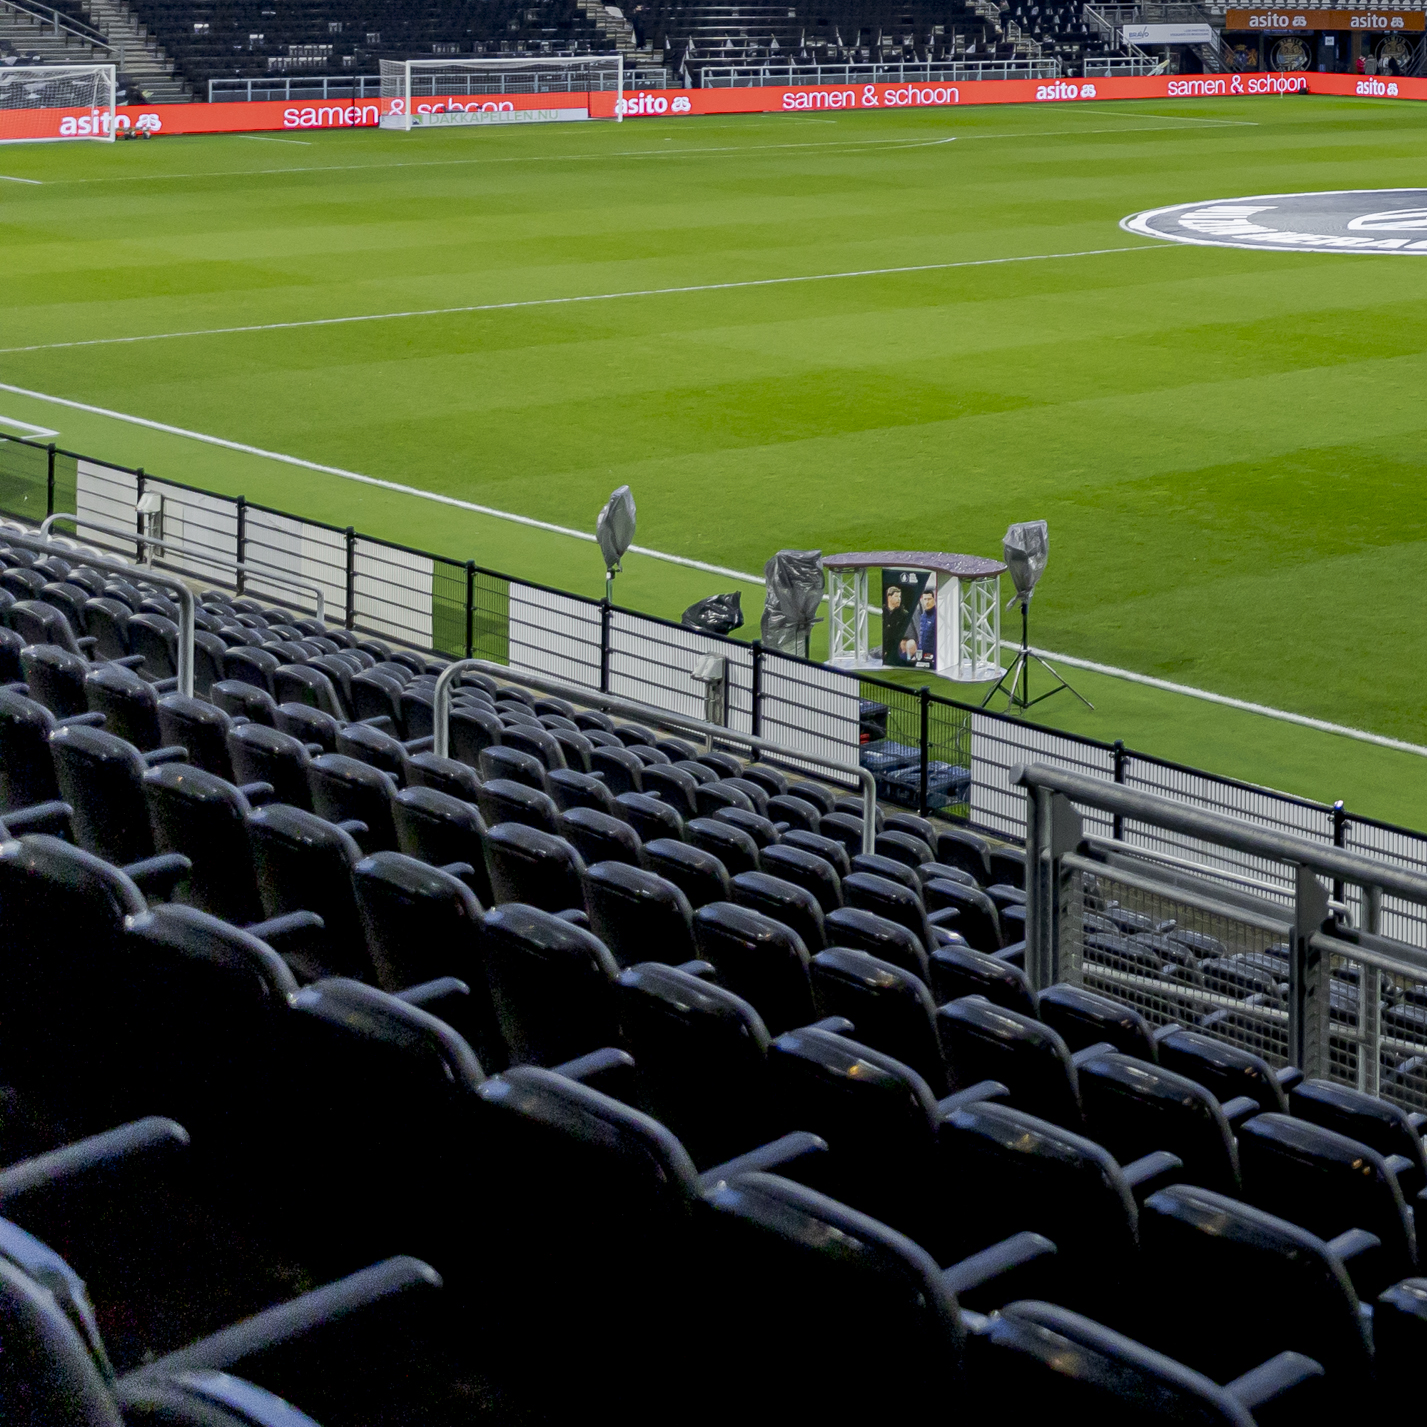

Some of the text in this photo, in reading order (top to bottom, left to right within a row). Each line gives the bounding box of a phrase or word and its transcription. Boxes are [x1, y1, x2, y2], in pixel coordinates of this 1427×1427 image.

[1249, 11, 1290, 28] asito
[1350, 12, 1388, 28] asito
[1036, 82, 1079, 100] asito
[1168, 73, 1307, 96] samen & schoon
[1355, 76, 1386, 96] asito
[615, 92, 668, 116] asito
[782, 83, 959, 110] samen & schoon
[60, 110, 131, 136] asito
[283, 103, 378, 128] samen
[428, 108, 559, 125] DAKKAPELLEN.NU
